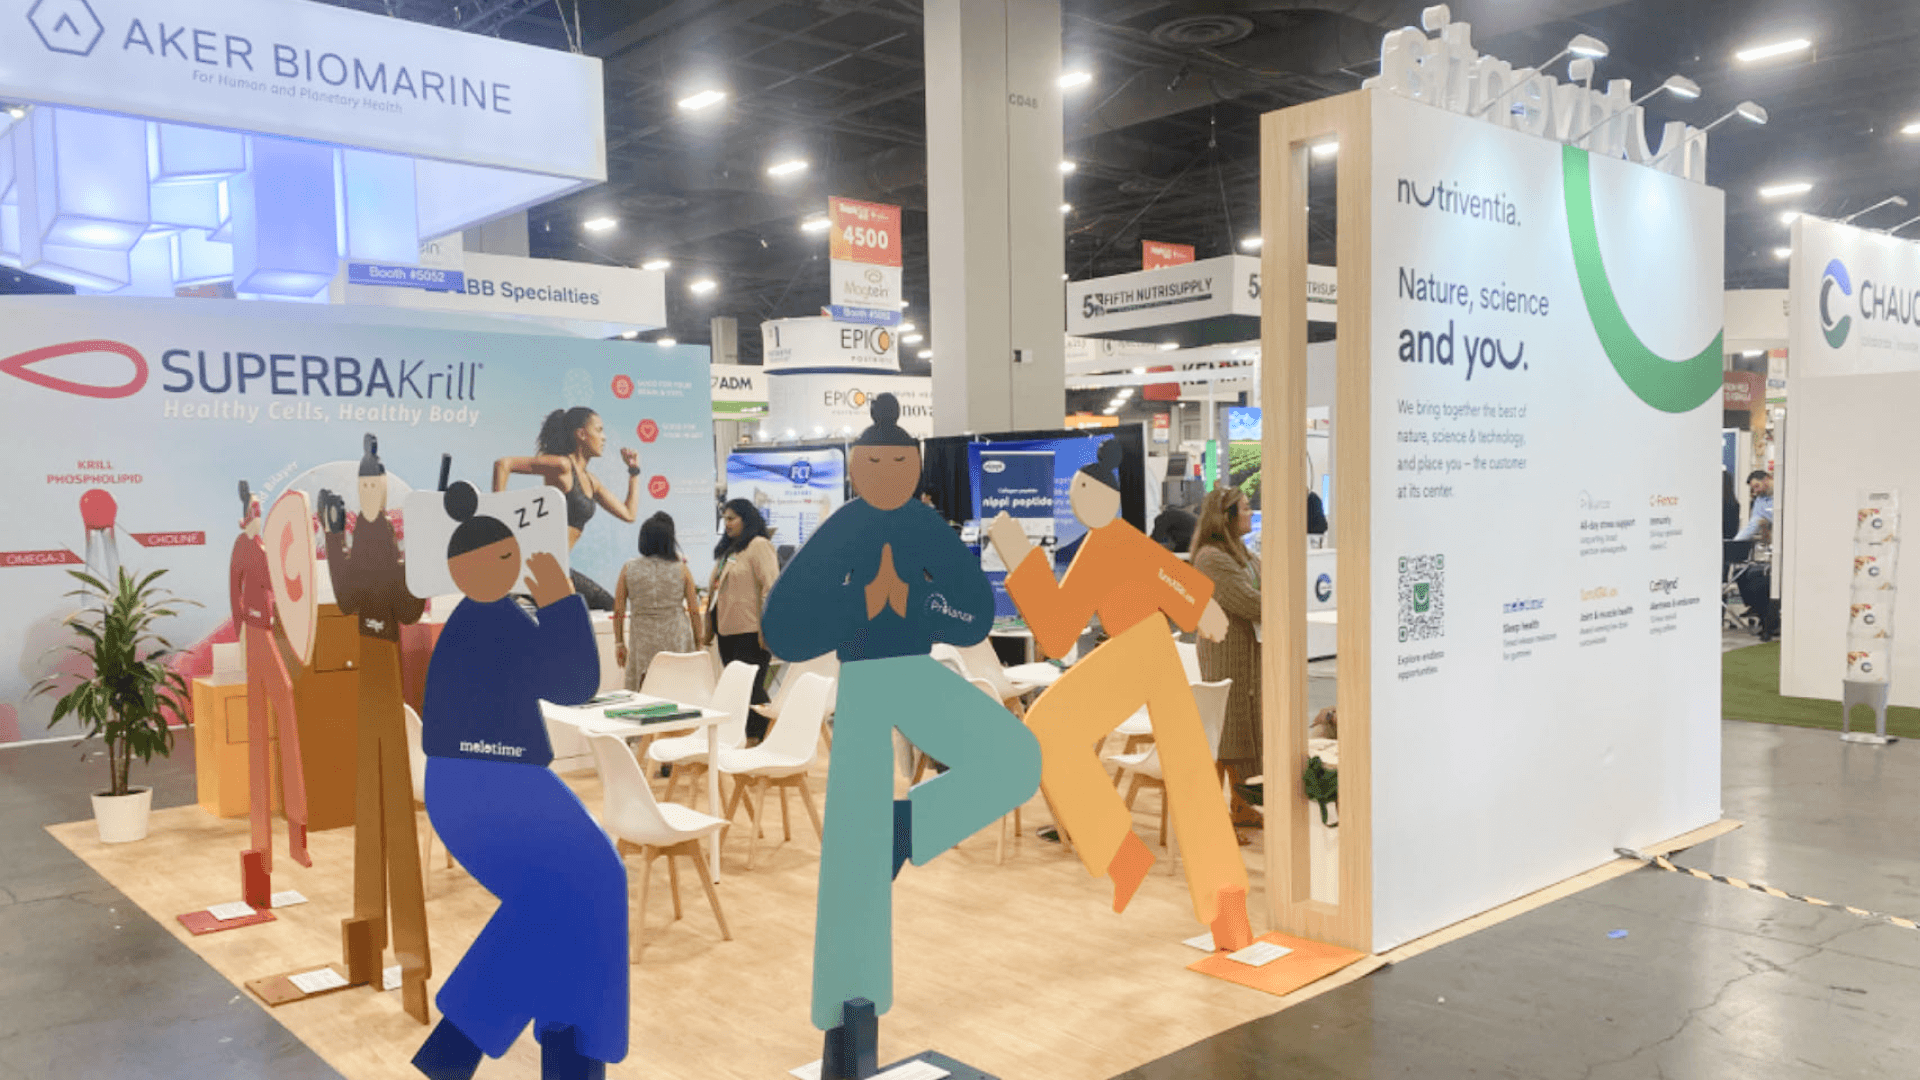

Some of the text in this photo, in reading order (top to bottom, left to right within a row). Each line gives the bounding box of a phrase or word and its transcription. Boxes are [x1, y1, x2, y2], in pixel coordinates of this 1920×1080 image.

[123, 17, 512, 114] AKER BIOMARINE
[192, 70, 403, 115] For Human and Planetary Health
[1398, 178, 1521, 227] nutriventia.
[843, 225, 889, 250] 4500
[500, 282, 600, 306] Specialties
[1104, 287, 1134, 303] FIFTH
[1137, 277, 1213, 301] NUTRISUPPLY
[1399, 265, 1550, 317] Nature, science
[1398, 318, 1529, 382] and you.
[719, 376, 753, 391] ADM
[163, 399, 480, 428] Healthy Cells, Healthy Body
[1397, 399, 1415, 415] We
[1416, 399, 1441, 420] bring
[1442, 400, 1481, 420] together
[1482, 401, 1496, 417] the
[1498, 401, 1517, 418] best
[1397, 428, 1526, 448] nature, science & technology,
[77, 460, 114, 470] KRILL
[1397, 454, 1416, 471] and
[1417, 455, 1443, 475] place
[1445, 458, 1462, 475] you
[1473, 454, 1487, 469] the
[1488, 458, 1527, 470] customer
[46, 473, 143, 485] PHOSPHOLIPID
[1397, 483, 1454, 499] at its center.
[982, 496, 1053, 509] nippi peptide
[148, 532, 200, 545] CHOLINE
[6, 552, 66, 564] OMEGA-3
